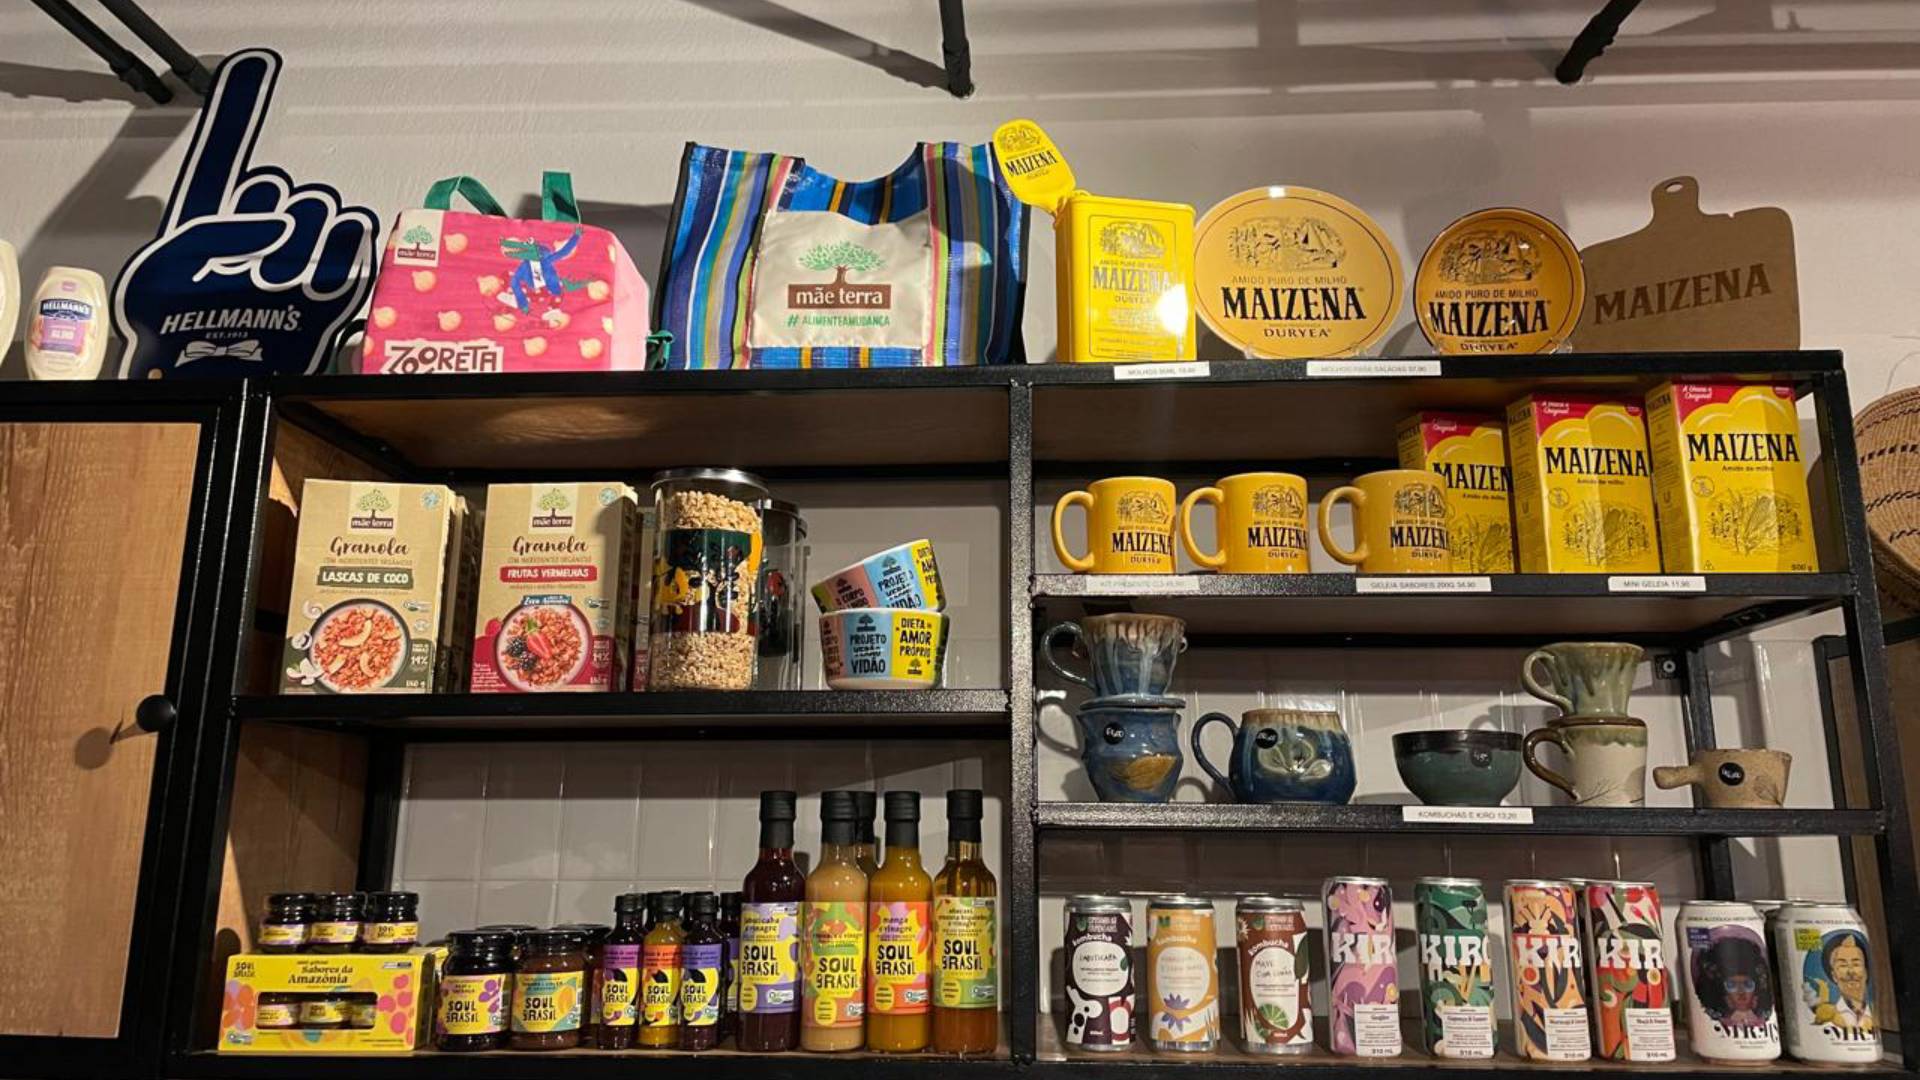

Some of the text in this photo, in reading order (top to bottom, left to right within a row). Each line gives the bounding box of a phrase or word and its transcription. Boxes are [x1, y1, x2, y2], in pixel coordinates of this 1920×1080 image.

[1004, 150, 1058, 177] MAIZENA
[795, 286, 883, 305] mãe terra
[1465, 290, 1491, 298] PURO
[1593, 262, 1774, 326] MAIZENA
[1221, 286, 1367, 320] MAIZENA
[160, 304, 302, 335] HELLMANN'S
[1428, 300, 1550, 337] MAIZENA
[1264, 328, 1330, 338] DURYEA
[1687, 433, 1801, 462] MAIZENA
[1544, 447, 1649, 477] MAIZENA
[330, 536, 409, 556] Granola
[512, 536, 589, 556] Granola
[322, 571, 409, 584] LASCAS DE COCO
[507, 568, 590, 579] FRUTAS VERMELHAS
[901, 618, 925, 629] DIETA
[850, 634, 887, 645] PROJETO
[900, 630, 932, 645] AMOR
[900, 644, 931, 657] PRÓPRIO
[851, 656, 886, 674] VIDÃO
[744, 945, 777, 962] SOUL
[878, 945, 913, 960] SOUL
[944, 940, 980, 955] SOUL
[1331, 932, 1396, 963] KIR
[302, 966, 354, 974] Sabores da
[742, 962, 780, 976] BRASIL
[818, 958, 857, 973] SOUL
[876, 962, 916, 976] BRASIL
[942, 956, 984, 970] BRASIL
[288, 974, 348, 984] Amazônia
[816, 974, 858, 989] BRASIL
[448, 1000, 477, 1011] SOUL
[525, 998, 555, 1008] SOUL
[446, 1012, 480, 1023] BRASIL
[522, 1010, 557, 1021] BRASIL
